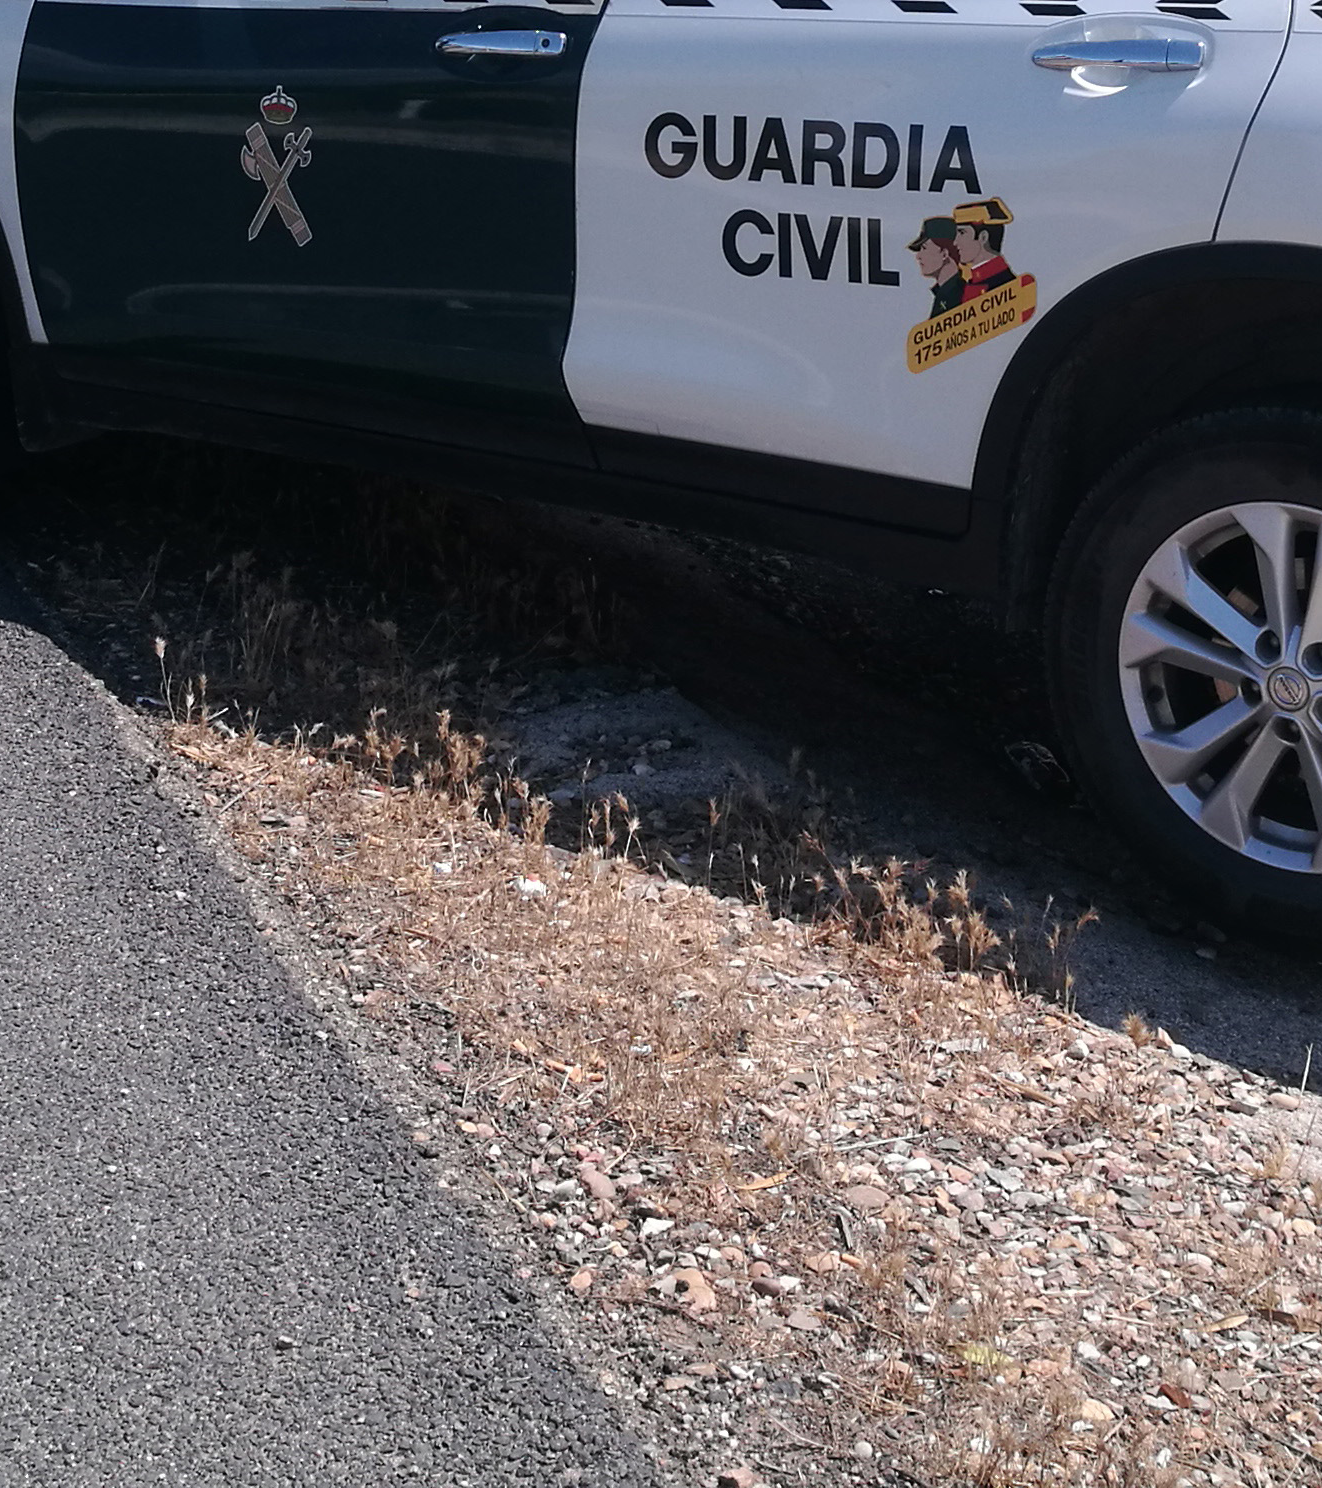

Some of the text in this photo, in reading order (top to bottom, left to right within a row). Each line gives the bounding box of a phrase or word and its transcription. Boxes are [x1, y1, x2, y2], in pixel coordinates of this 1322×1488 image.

[644, 111, 982, 195] GUARDIA
[722, 208, 901, 287] CIVIL
[913, 287, 1017, 345] GUARDIA CIVIL
[914, 307, 1016, 365] 175 AÑOS A TU LADO
